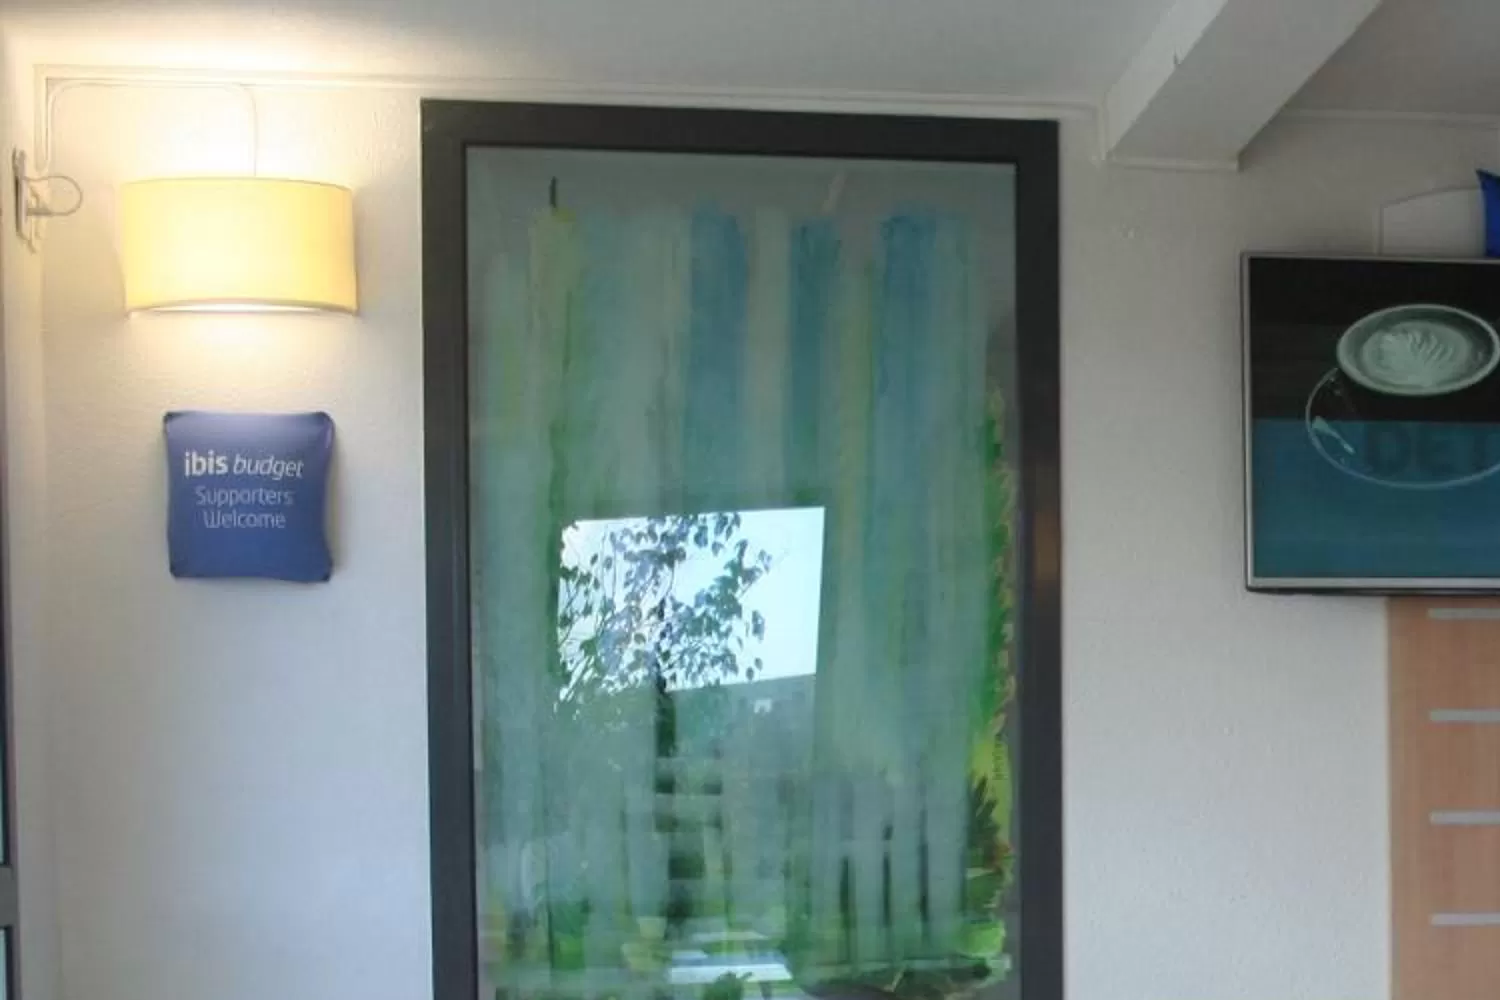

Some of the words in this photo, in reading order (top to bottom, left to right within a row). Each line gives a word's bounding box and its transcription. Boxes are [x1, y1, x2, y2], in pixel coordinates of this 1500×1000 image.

[185, 449, 228, 478] ibis
[233, 454, 304, 480] budget
[195, 486, 293, 508] Supporters
[203, 510, 286, 529] Welcome
